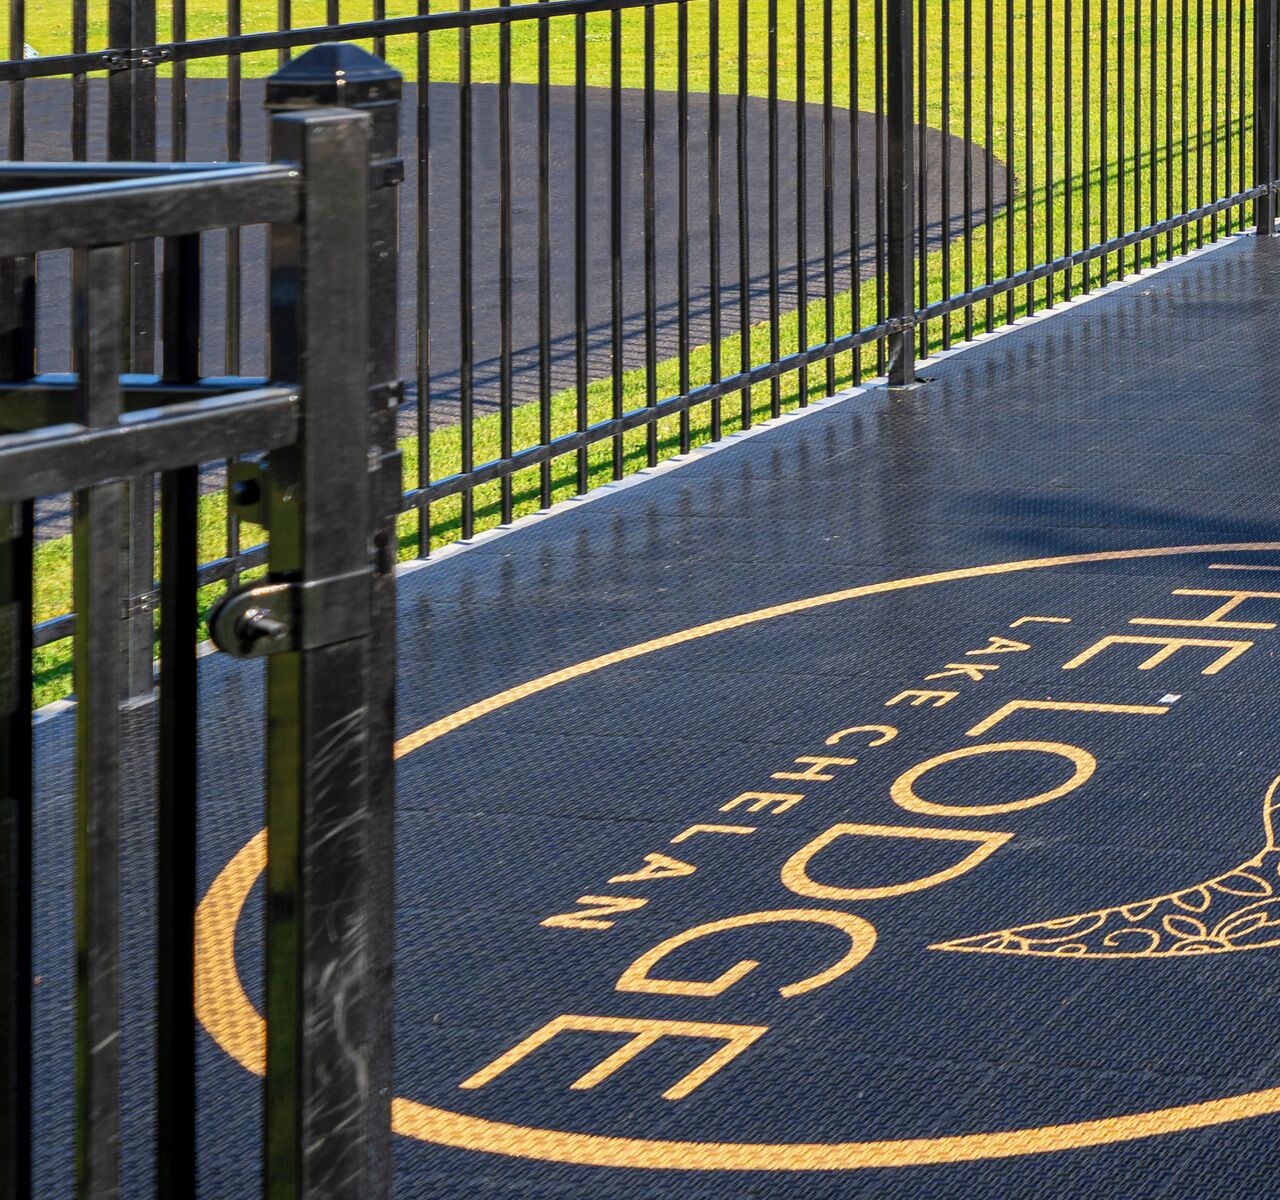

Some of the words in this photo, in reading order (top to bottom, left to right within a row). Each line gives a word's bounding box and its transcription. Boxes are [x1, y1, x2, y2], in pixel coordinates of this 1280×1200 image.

[885, 615, 1072, 708] LAKE
[459, 698, 1170, 1101] LODGE
[539, 724, 899, 931] CHELAN
